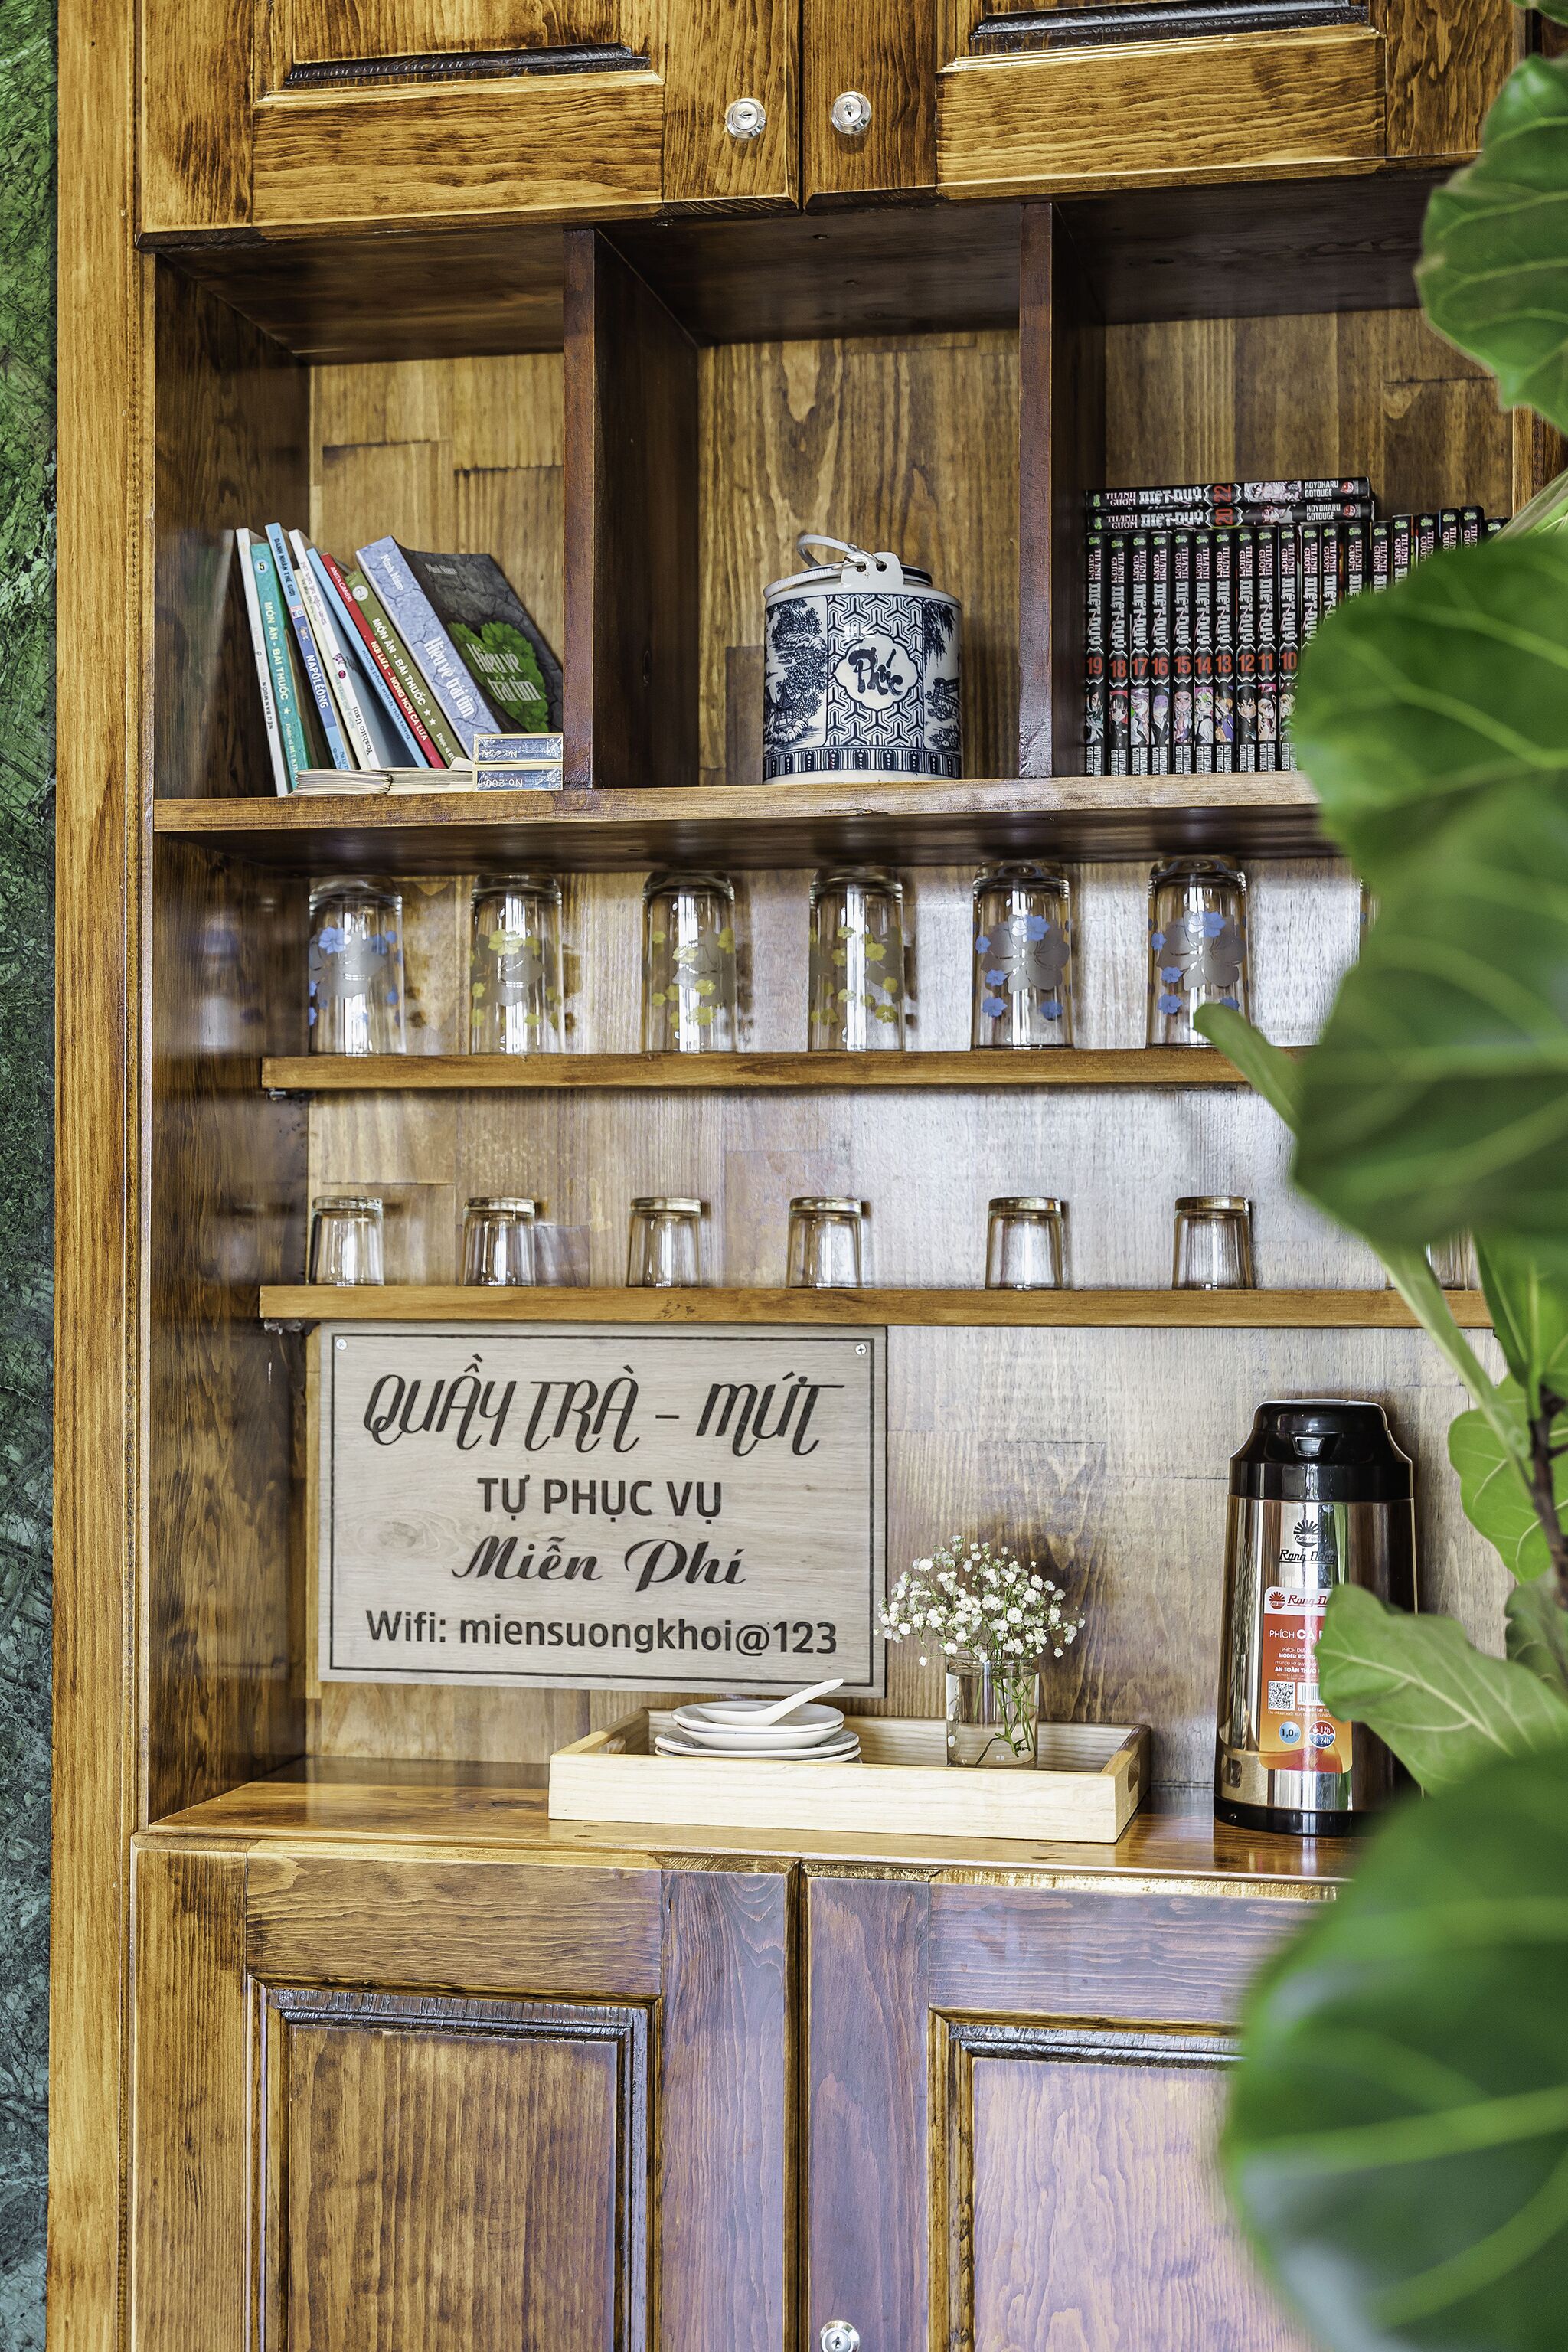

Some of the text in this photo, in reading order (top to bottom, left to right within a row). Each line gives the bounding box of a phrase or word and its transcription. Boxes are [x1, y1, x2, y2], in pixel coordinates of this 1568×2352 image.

[1213, 485, 1232, 502] 22
[1305, 480, 1339, 489] KOYOHARU
[1305, 488, 1332, 497] GOTOUGE
[1105, 492, 1136, 500] THANH
[1215, 508, 1233, 525] 20
[1306, 504, 1341, 512] KOYOHARU
[1307, 511, 1334, 521] GOTOUGE
[1106, 514, 1138, 523] THANH
[330, 567, 342, 584] ANITA
[372, 618, 389, 640] MÓN
[394, 658, 408, 676] BÀI
[404, 675, 427, 706] THUỐC
[1087, 657, 1102, 675] 19
[1110, 660, 1126, 678] 18
[1132, 658, 1148, 675] 17
[1152, 657, 1168, 675] 16
[1174, 656, 1191, 674] 15
[1195, 657, 1212, 675] 14
[1216, 655, 1232, 674] 13
[1238, 654, 1255, 672] 12
[1258, 653, 1273, 671] 11
[1281, 652, 1298, 670] 10
[353, 707, 373, 756] Yoshito Usui
[364, 1354, 517, 1451] QUẦY
[530, 1364, 640, 1453] TRÀ
[696, 1370, 845, 1457] MỨT
[477, 1474, 722, 1524] TỰ PHỤC VỤ
[452, 1536, 746, 1592] Miễn Phí
[366, 1609, 838, 1657] Wifi: miensuongkhoi@123
[1269, 1628, 1295, 1639] PHÍCH
[1281, 1728, 1294, 1739] 1,0
